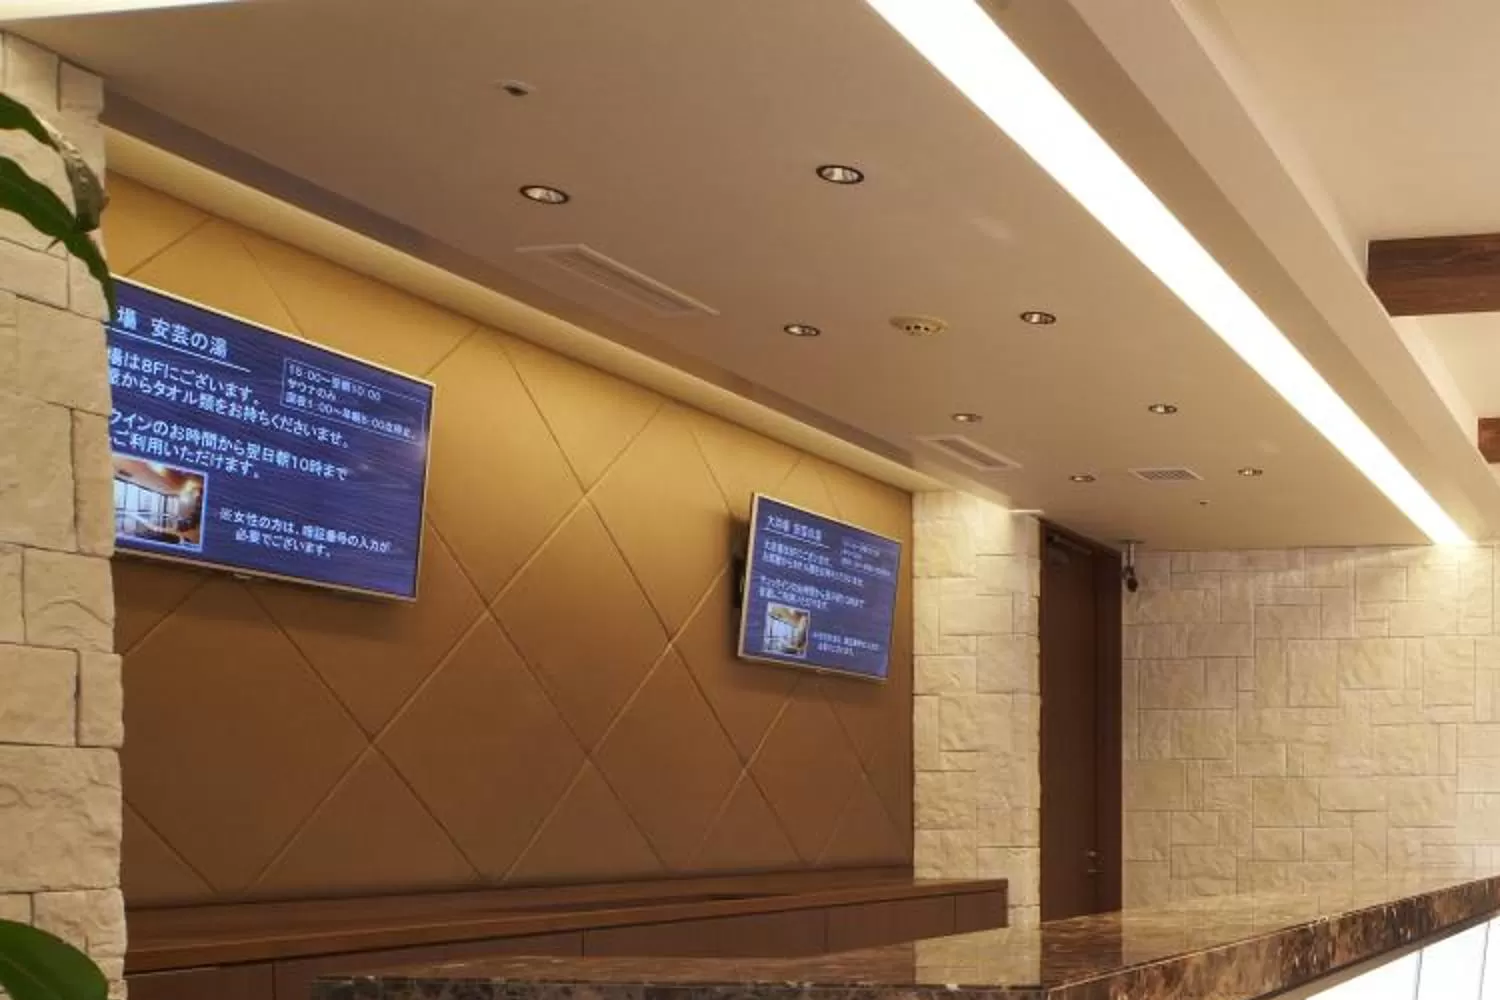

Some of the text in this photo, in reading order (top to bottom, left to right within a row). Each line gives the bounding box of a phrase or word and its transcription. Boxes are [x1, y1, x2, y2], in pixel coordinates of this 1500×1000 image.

[151, 317, 228, 359] 安芸の湯
[110, 432, 261, 479] ご利用いただけます。
